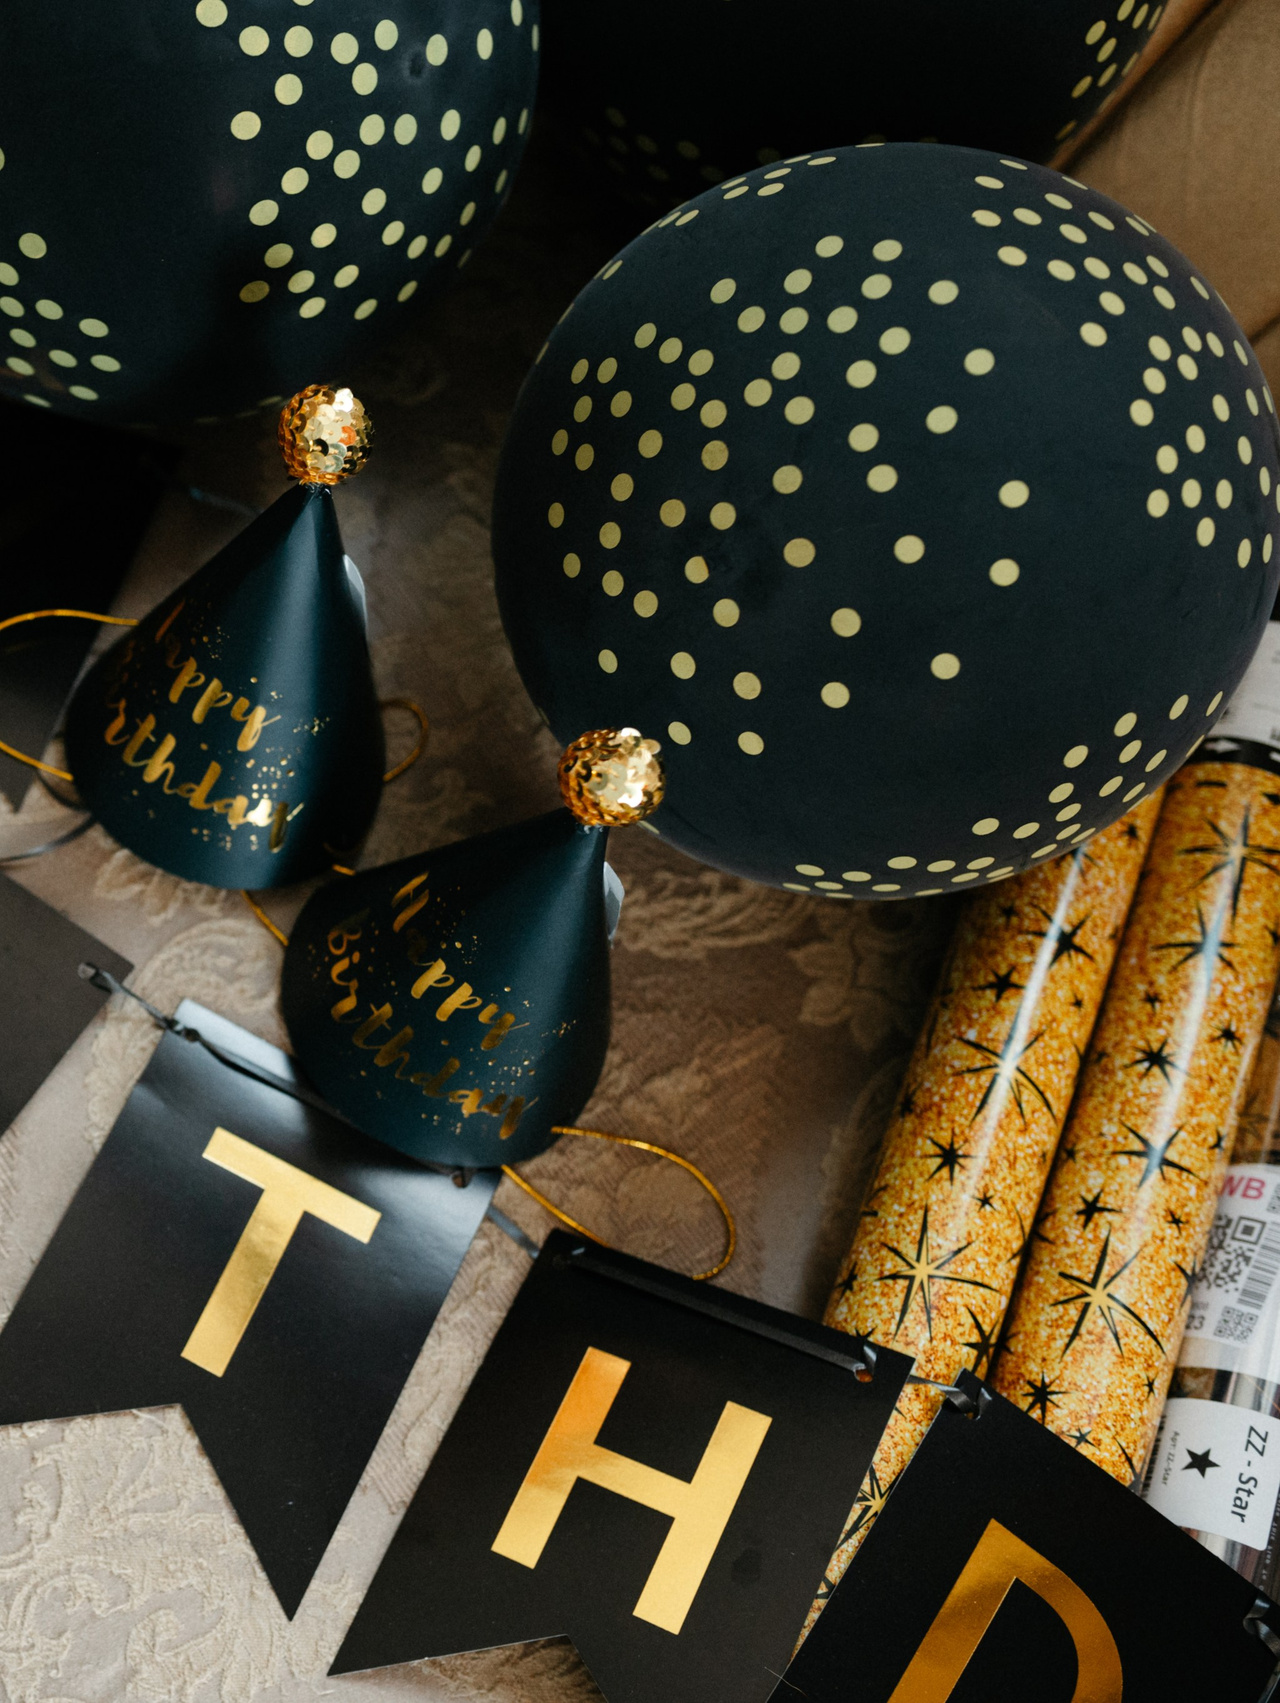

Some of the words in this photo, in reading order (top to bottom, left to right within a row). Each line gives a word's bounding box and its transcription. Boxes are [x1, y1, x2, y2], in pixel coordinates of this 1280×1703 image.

[391, 870, 531, 1051] Happy
[1244, 1425, 1269, 1457] ZZ
[1231, 1472, 1258, 1523] Star
